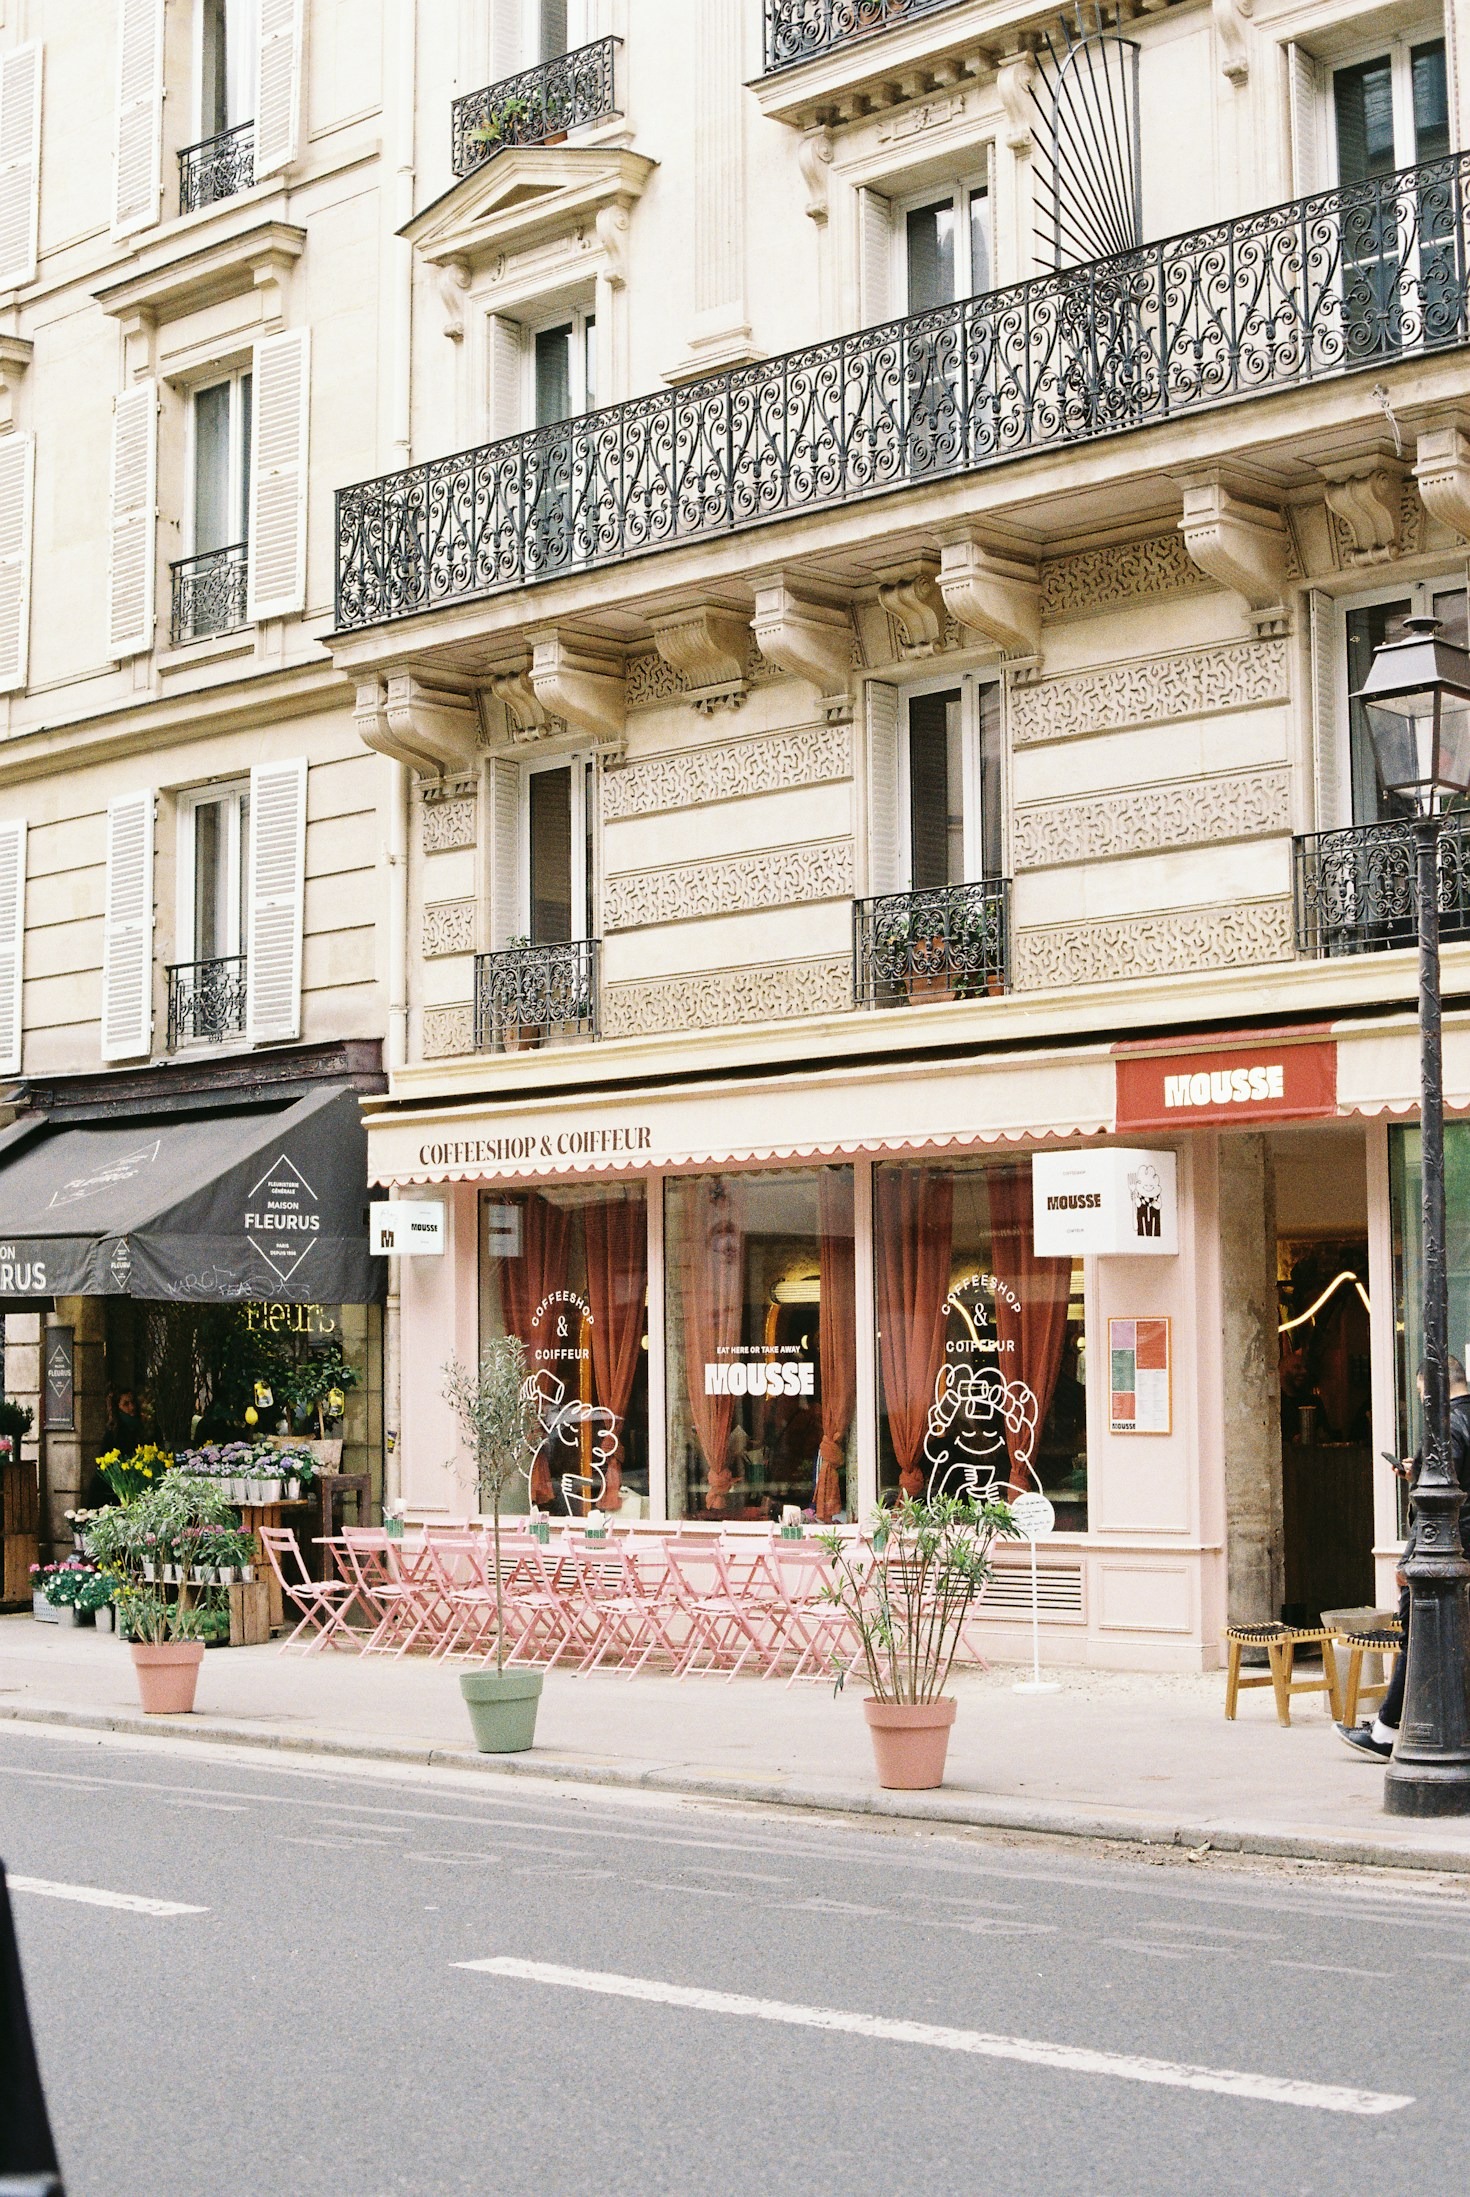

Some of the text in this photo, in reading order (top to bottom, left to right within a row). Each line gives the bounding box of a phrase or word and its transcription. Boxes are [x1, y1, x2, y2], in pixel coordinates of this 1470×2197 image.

[1164, 1065, 1284, 1108] MOUSSE
[419, 1127, 651, 1165] COFFEESHOP & COIFFEUR
[267, 1201, 299, 1210] MAISON
[1047, 1194, 1101, 1211] MOUSSE
[244, 1213, 320, 1230] FLEURUS
[411, 1224, 438, 1232] MOUSSE
[1, 1262, 47, 1290] RUS
[941, 1274, 1021, 1315] COFFEESHOP
[246, 1300, 335, 1333] Fleurs
[531, 1290, 595, 1327] COFFEESHOP
[973, 1302, 988, 1326] &
[556, 1315, 569, 1337] &
[535, 1348, 590, 1360] COIFFEUR
[717, 1345, 801, 1354] EAT HERE OR TAKE AWAY
[946, 1339, 1015, 1352] COIFFEUR
[704, 1361, 814, 1396] MOUSSE
[1112, 1423, 1136, 1431] MOUSSE
